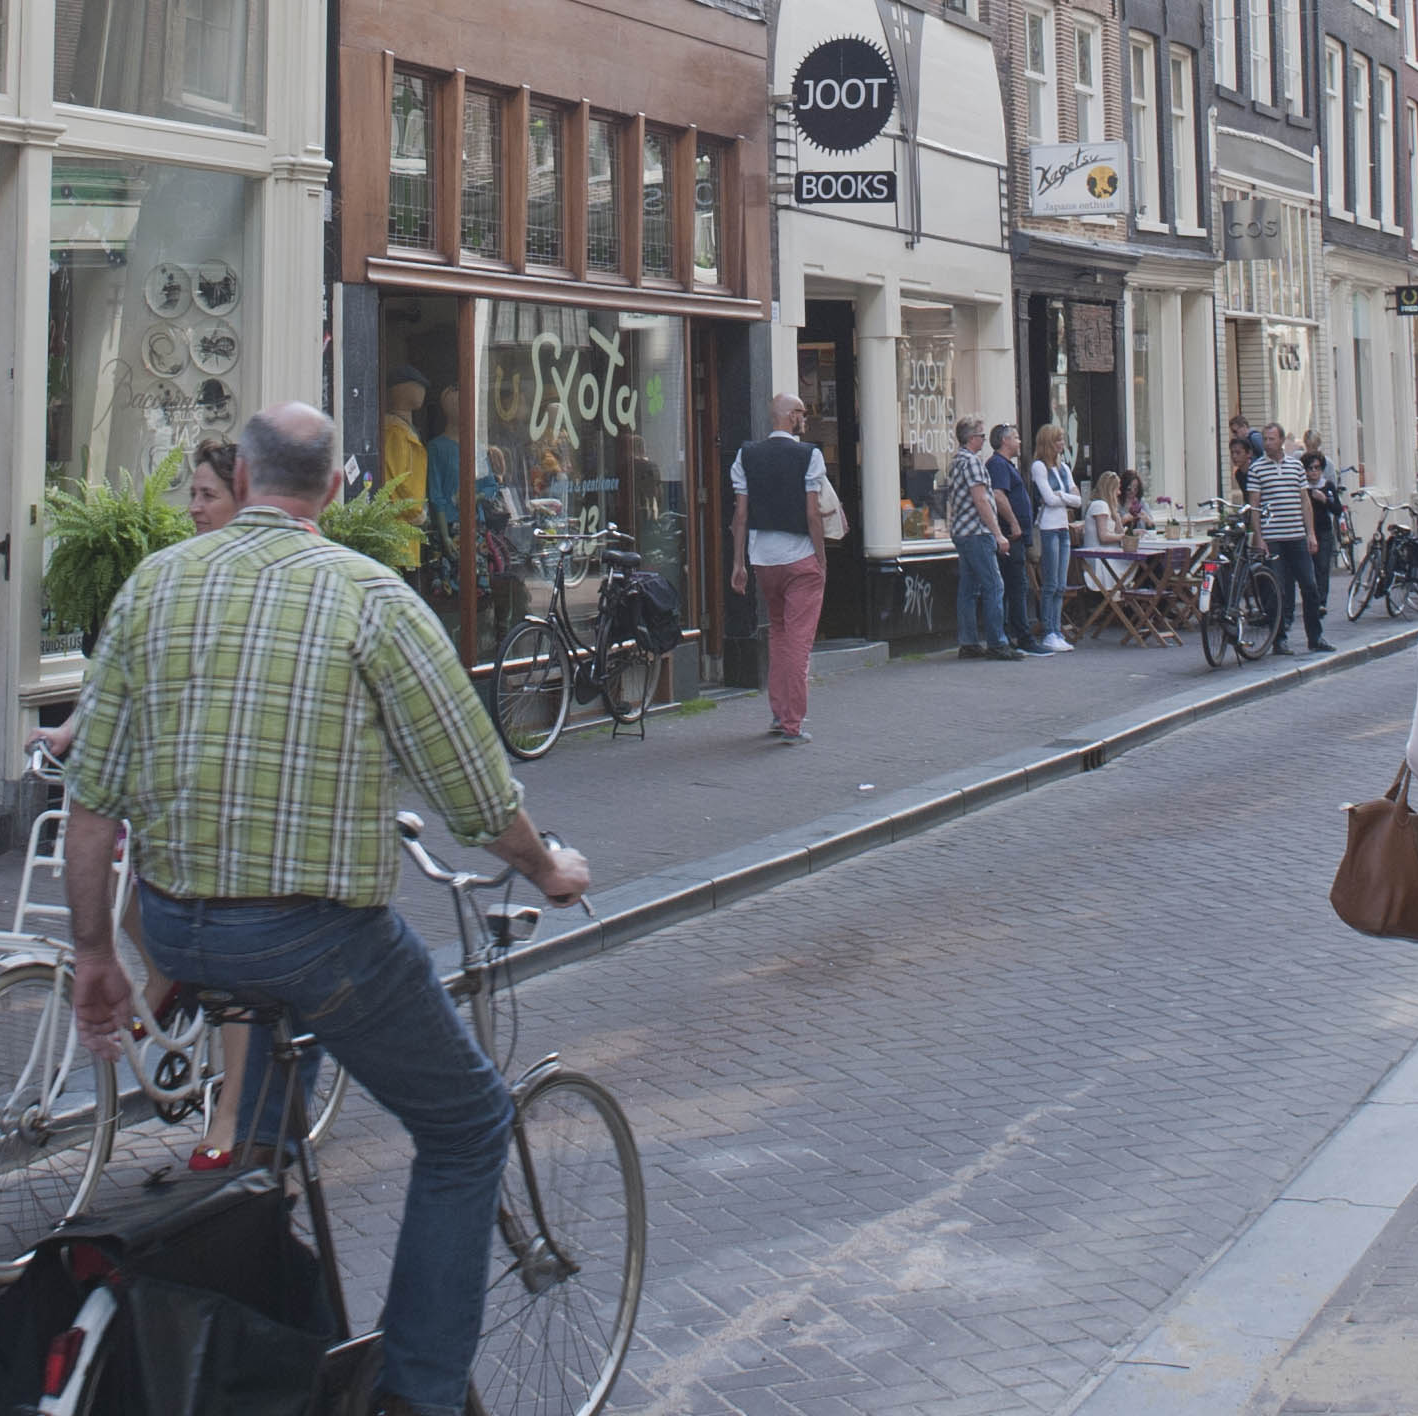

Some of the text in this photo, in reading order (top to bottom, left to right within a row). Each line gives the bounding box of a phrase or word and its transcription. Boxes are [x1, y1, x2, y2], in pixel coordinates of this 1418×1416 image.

[799, 78, 888, 111] JOOT
[802, 174, 888, 199] BOOKS
[1228, 220, 1278, 239] COS
[529, 326, 638, 450] Exota
[910, 359, 946, 391] JOOT
[908, 394, 955, 425] BOOKS
[909, 429, 955, 454] PHOTOS
